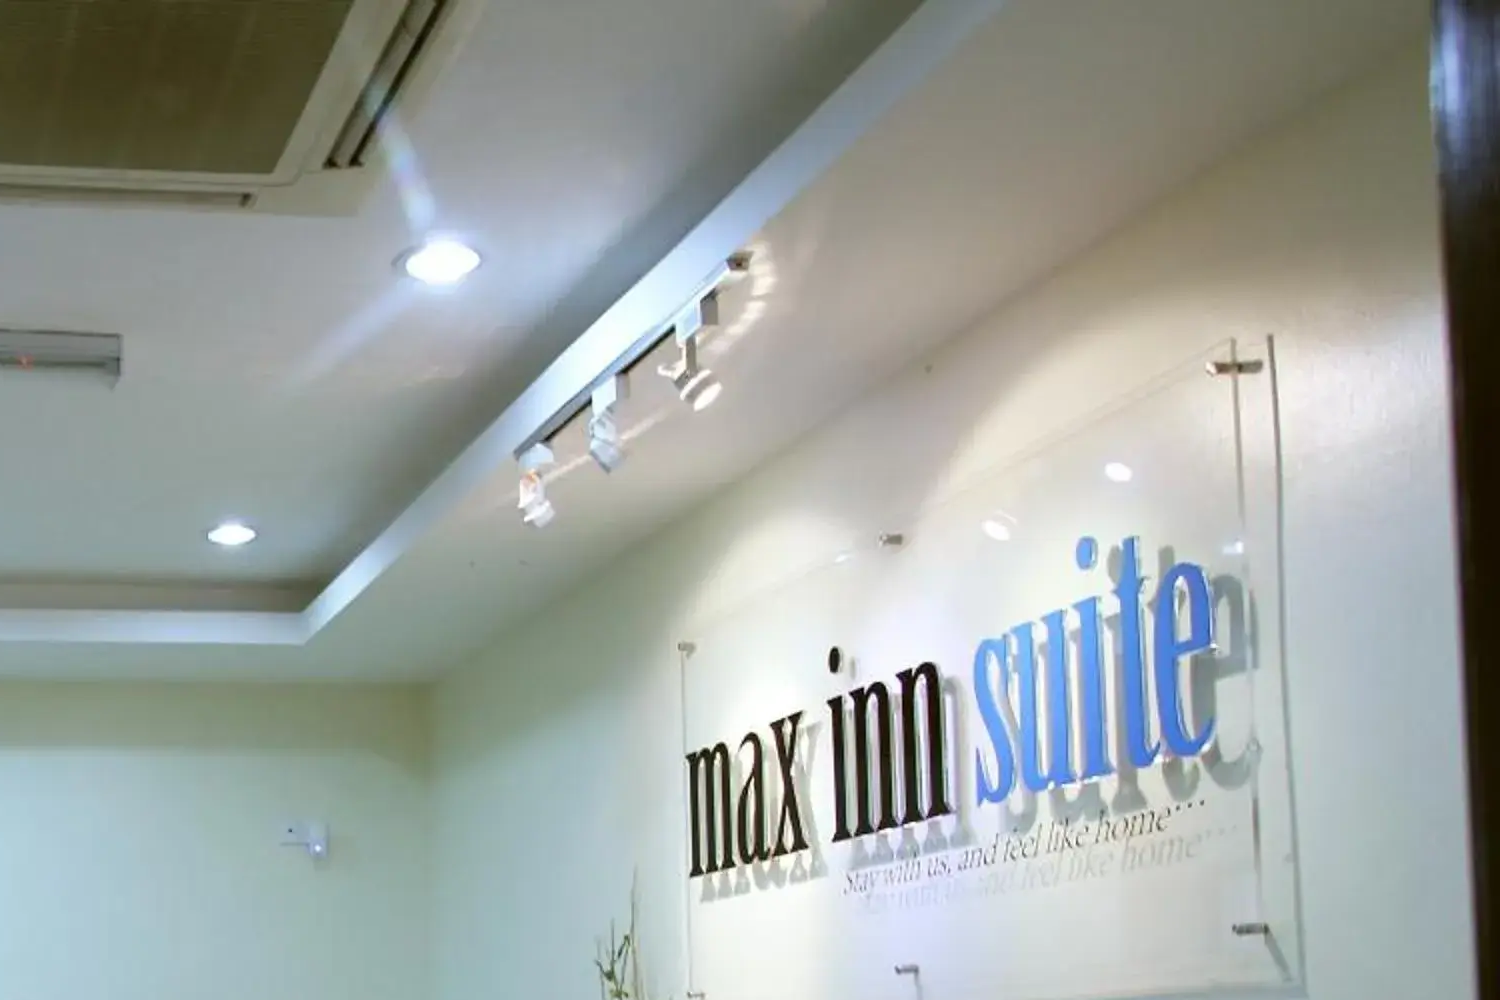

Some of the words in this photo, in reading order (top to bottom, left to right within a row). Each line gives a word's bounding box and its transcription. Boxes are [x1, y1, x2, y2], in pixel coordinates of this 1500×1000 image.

[686, 710, 810, 878] max
[828, 645, 952, 842] inn
[973, 535, 1217, 809] suite
[843, 867, 880, 896] Stay
[883, 850, 922, 886] with
[957, 832, 1000, 872] and
[1002, 820, 1044, 864] feel
[1046, 815, 1090, 854] like
